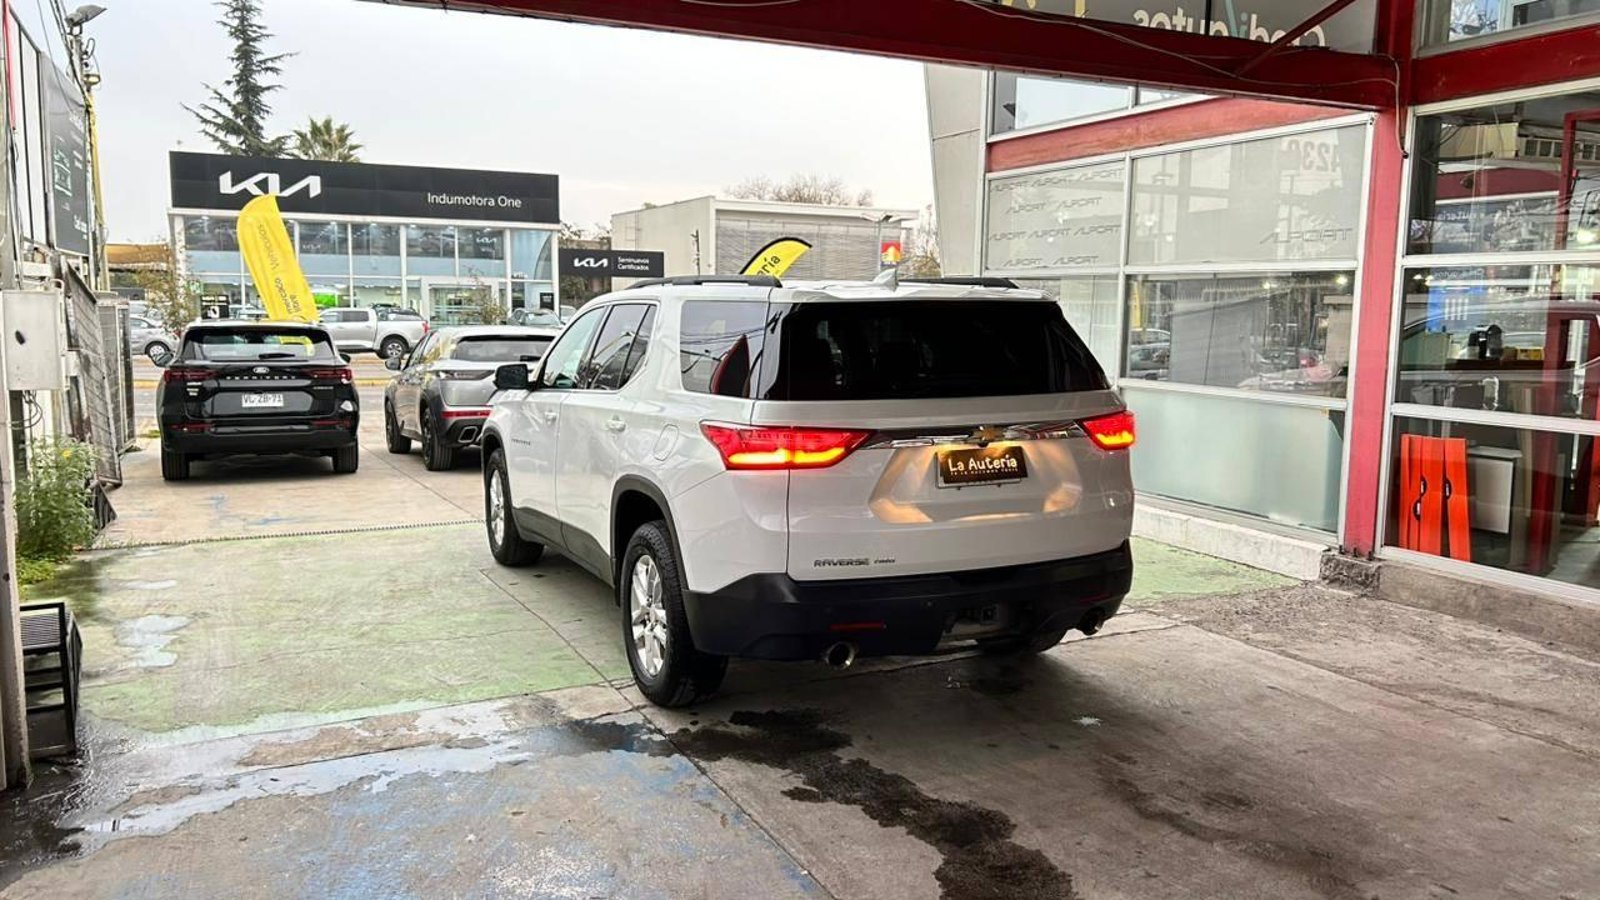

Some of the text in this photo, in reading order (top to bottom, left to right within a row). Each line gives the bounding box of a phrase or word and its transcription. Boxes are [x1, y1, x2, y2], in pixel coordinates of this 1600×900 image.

[219, 171, 321, 198] KIA
[427, 192, 522, 208] Indumotora One
[573, 257, 609, 268] KIA
[617, 256, 650, 264] Seminuevos
[617, 263, 650, 271] Certificados
[948, 459, 965, 472] La
[813, 557, 870, 568] RAVERSE
